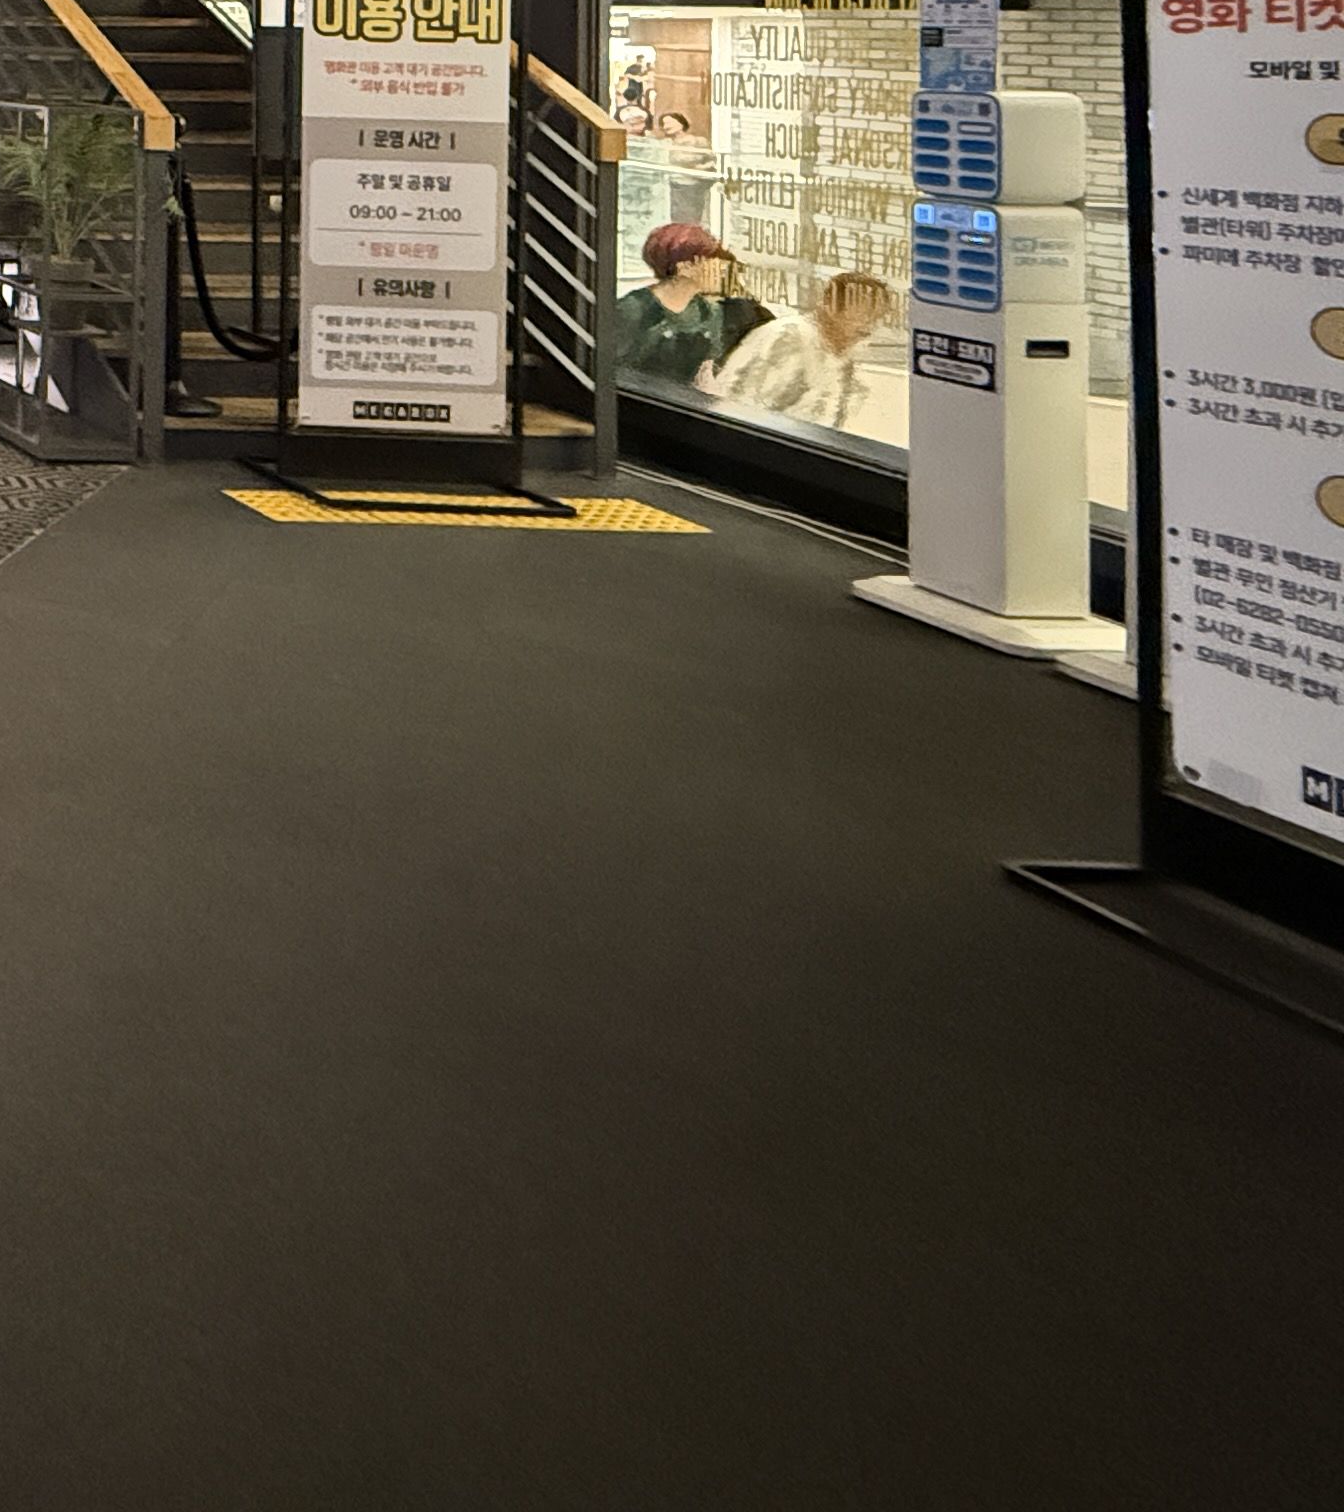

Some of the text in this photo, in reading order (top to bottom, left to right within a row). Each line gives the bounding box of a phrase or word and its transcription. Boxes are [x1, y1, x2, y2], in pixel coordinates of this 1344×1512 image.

[407, 63, 428, 76] 대기
[1246, 60, 1341, 80] 모바일 및
[373, 130, 441, 150] 운영 시간
[357, 174, 451, 192] 주말 및 공휴일
[1182, 187, 1238, 207] 신세계
[1243, 191, 1299, 213] 백화점
[349, 204, 462, 222] 09:00 21:00
[1181, 215, 1271, 240] 별관(타워)
[1245, 250, 1301, 274] 주차장
[372, 279, 435, 299] 유의사항
[1187, 368, 1239, 393] 3시간
[1187, 397, 1239, 423] 3시간
[1243, 407, 1283, 431] 초과
[1287, 415, 1307, 436] 시
[1191, 527, 1341, 581] 타 매장 및 백화점
[1193, 558, 1337, 611] 별관 무인 정산기
[1195, 615, 1244, 645] 3시간
[1249, 633, 1287, 658] 초과
[1292, 645, 1310, 666] 시
[1195, 645, 1252, 678] 모바일
